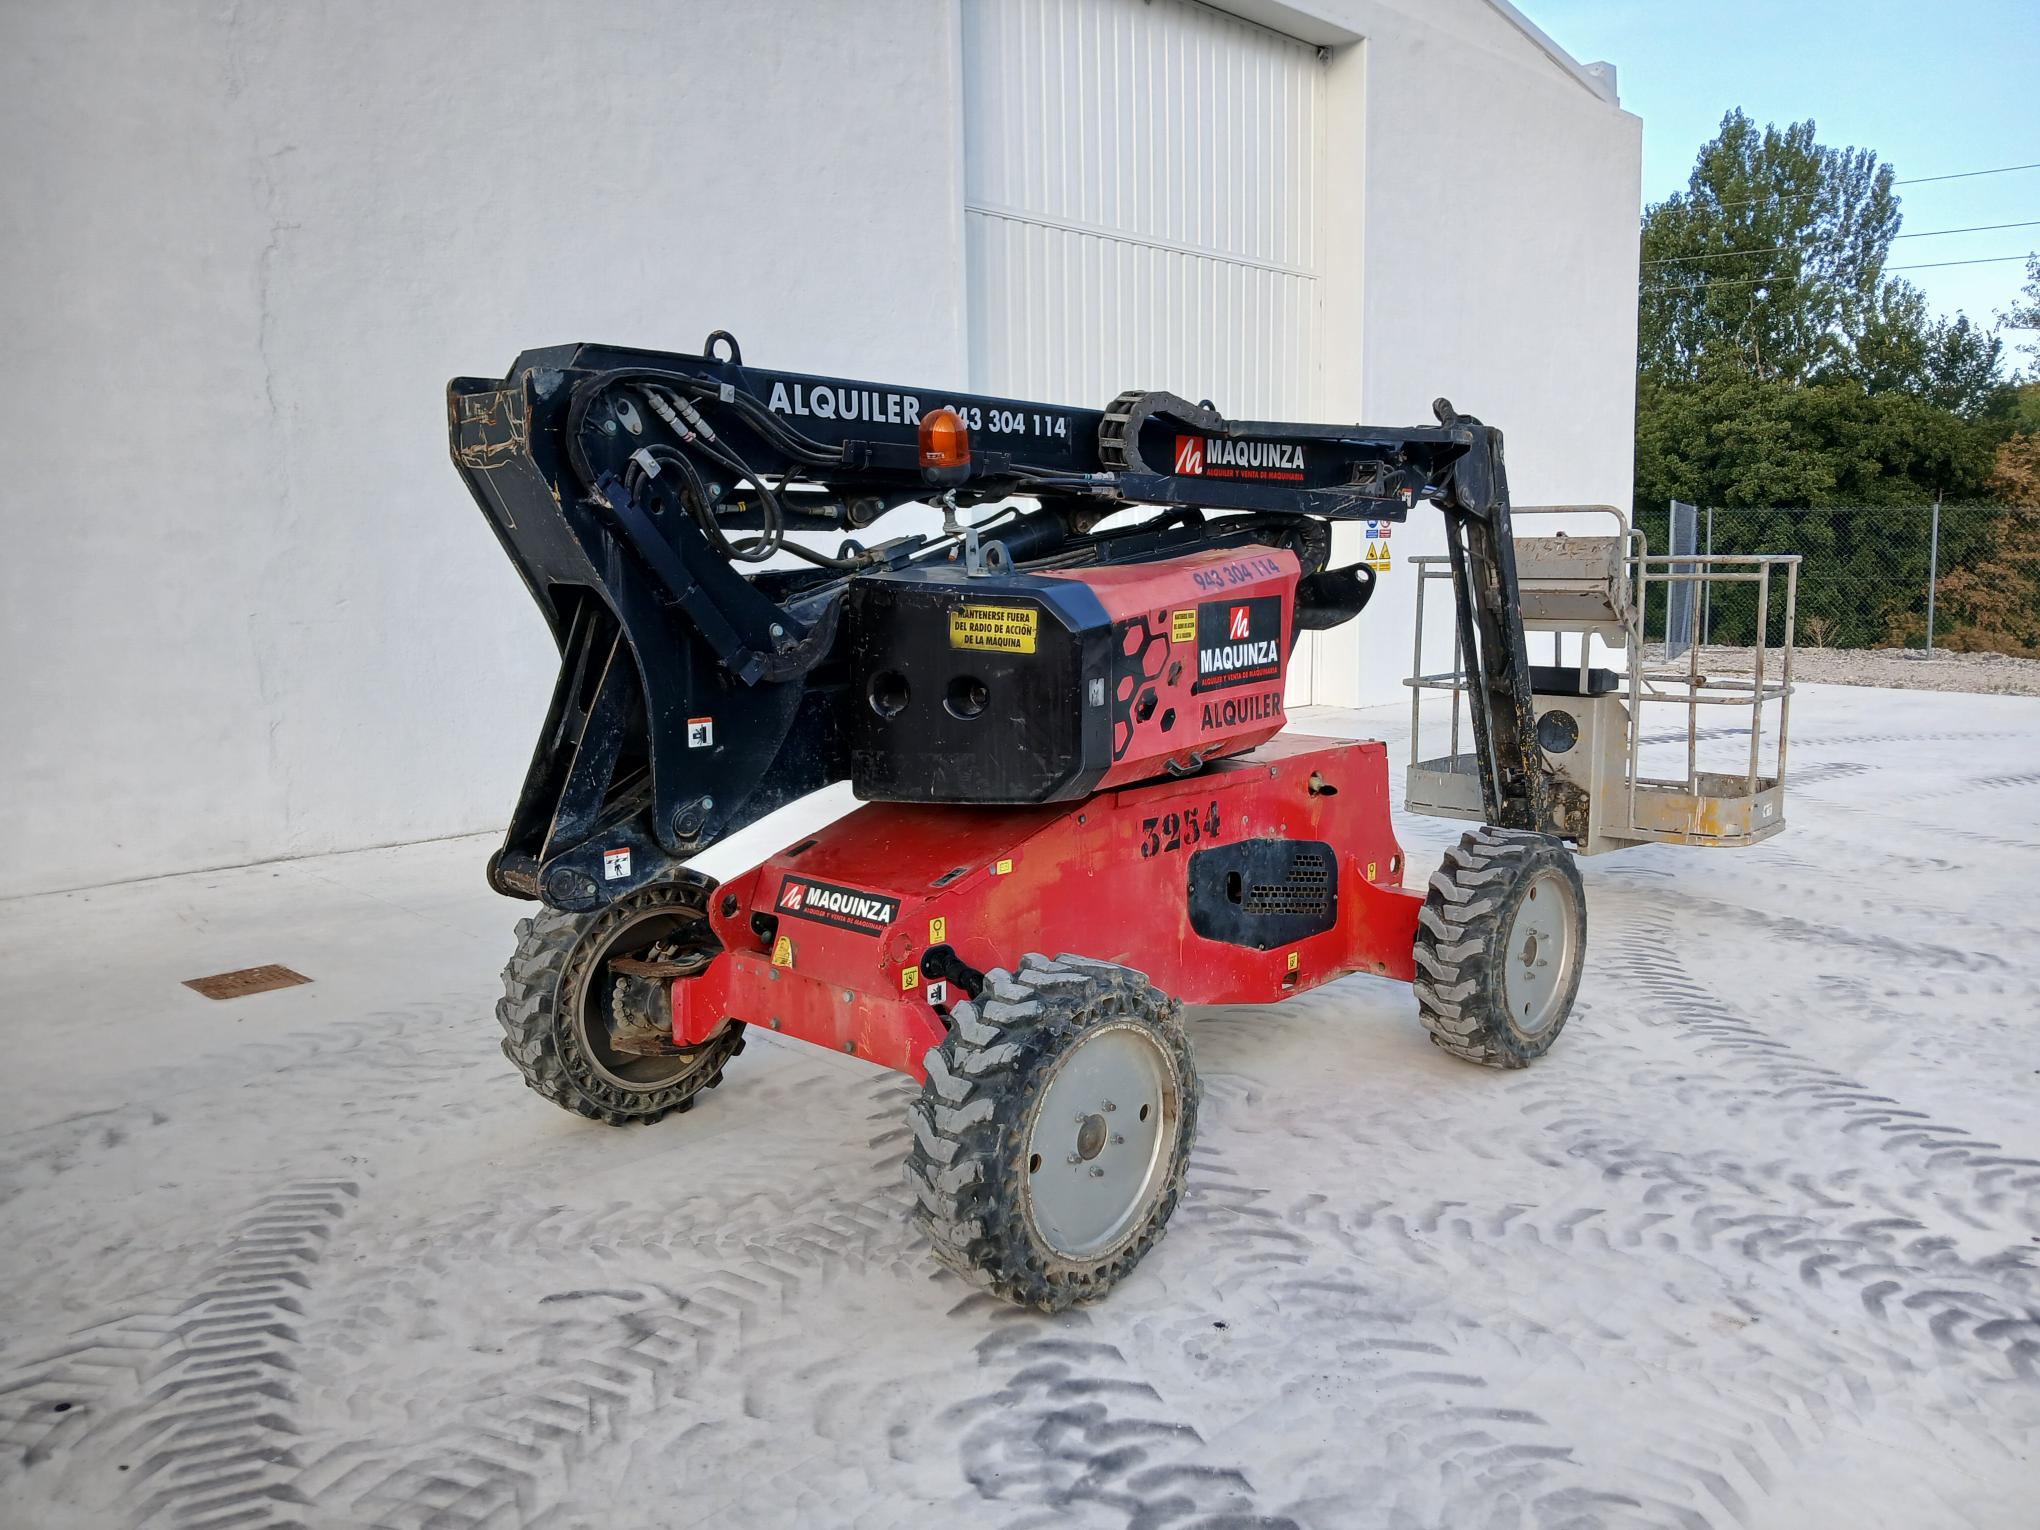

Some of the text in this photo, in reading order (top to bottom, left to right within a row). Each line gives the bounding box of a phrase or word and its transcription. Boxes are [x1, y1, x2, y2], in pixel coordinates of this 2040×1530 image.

[768, 382, 1066, 438] ALQUILER 43 304 114
[1206, 439, 1305, 469] MAQUINZA
[1193, 558, 1281, 590] 943 304 114
[954, 621, 967, 631] DEL
[969, 622, 992, 633] RADIO
[994, 624, 1003, 633] DE
[1007, 612, 1030, 622] FUERA
[964, 634, 973, 644] DE
[975, 635, 984, 645] LA
[1200, 640, 1278, 674] MAQUINZA
[1201, 692, 1281, 731] ALQUILER
[1141, 801, 1220, 860] 3254
[805, 887, 891, 923] MAQUINZA
